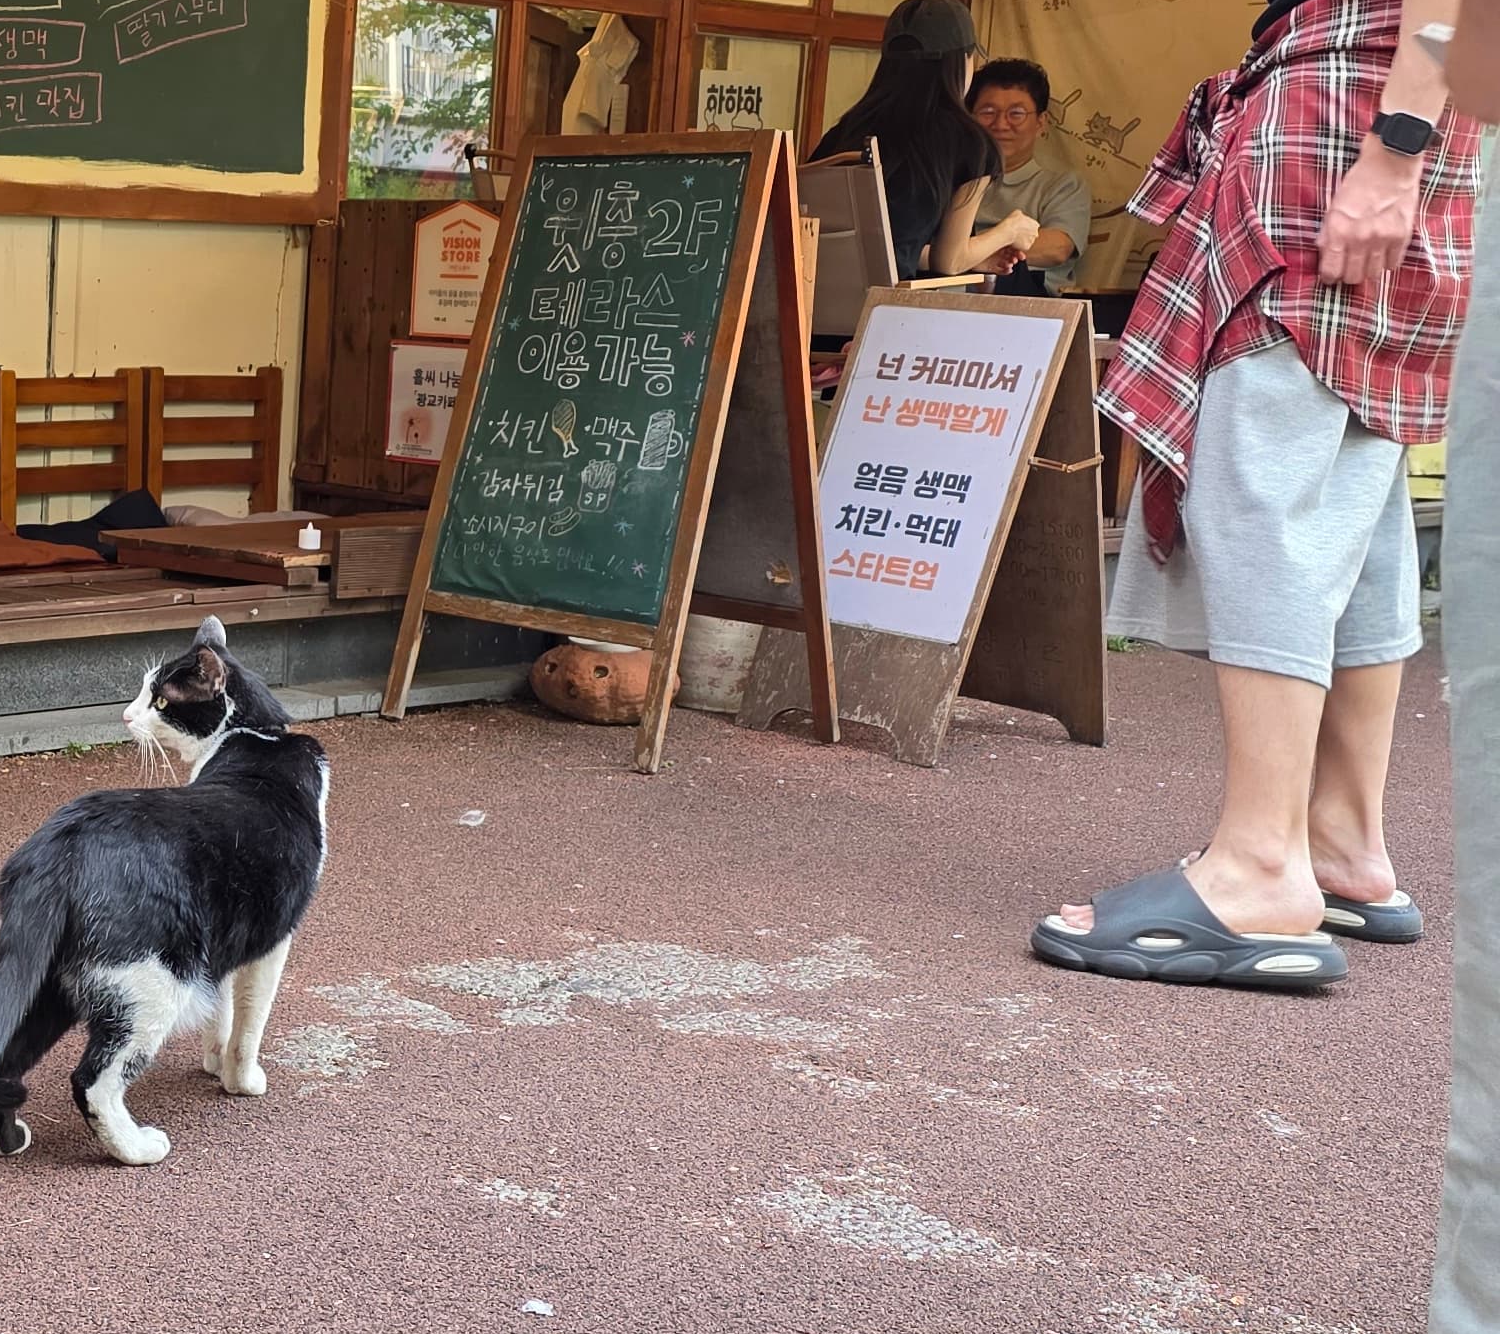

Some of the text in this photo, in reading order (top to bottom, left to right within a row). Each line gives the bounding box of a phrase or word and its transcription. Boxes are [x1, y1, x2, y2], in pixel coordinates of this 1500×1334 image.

[36, 83, 85, 120] 맛집
[442, 236, 481, 250] VISION
[543, 180, 723, 273] 윗층 2F
[441, 250, 481, 263] STORE
[529, 271, 682, 330] 테라스
[876, 352, 1023, 393] 넌 커피마셔
[862, 394, 1009, 437] 난 생맥할게
[853, 462, 973, 504] 얼음 생맥
[828, 549, 940, 591] 스타트업
